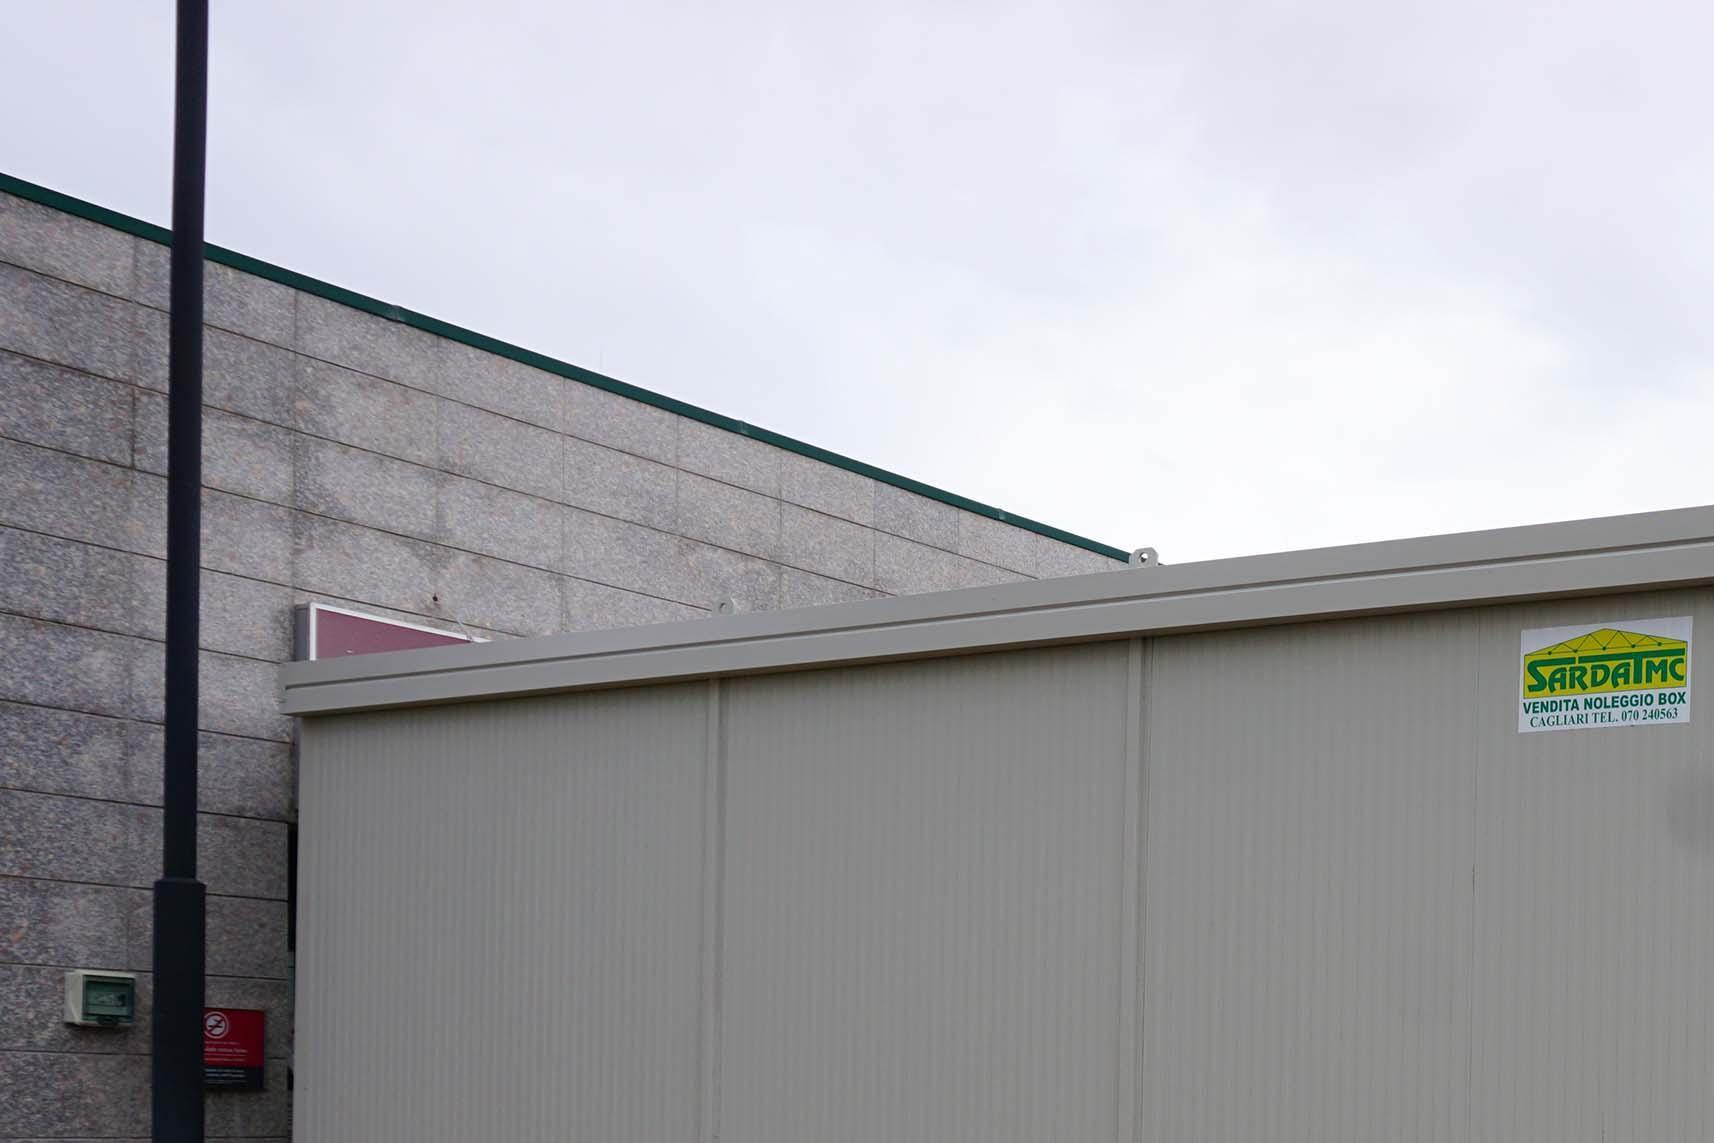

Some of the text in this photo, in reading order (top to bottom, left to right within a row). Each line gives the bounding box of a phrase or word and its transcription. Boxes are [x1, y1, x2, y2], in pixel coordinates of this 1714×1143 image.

[1523, 692, 1686, 714] VENDITA NOLEGGIO BOX
[1530, 707, 1678, 728] CAGLIARI TEL. 070 240563
